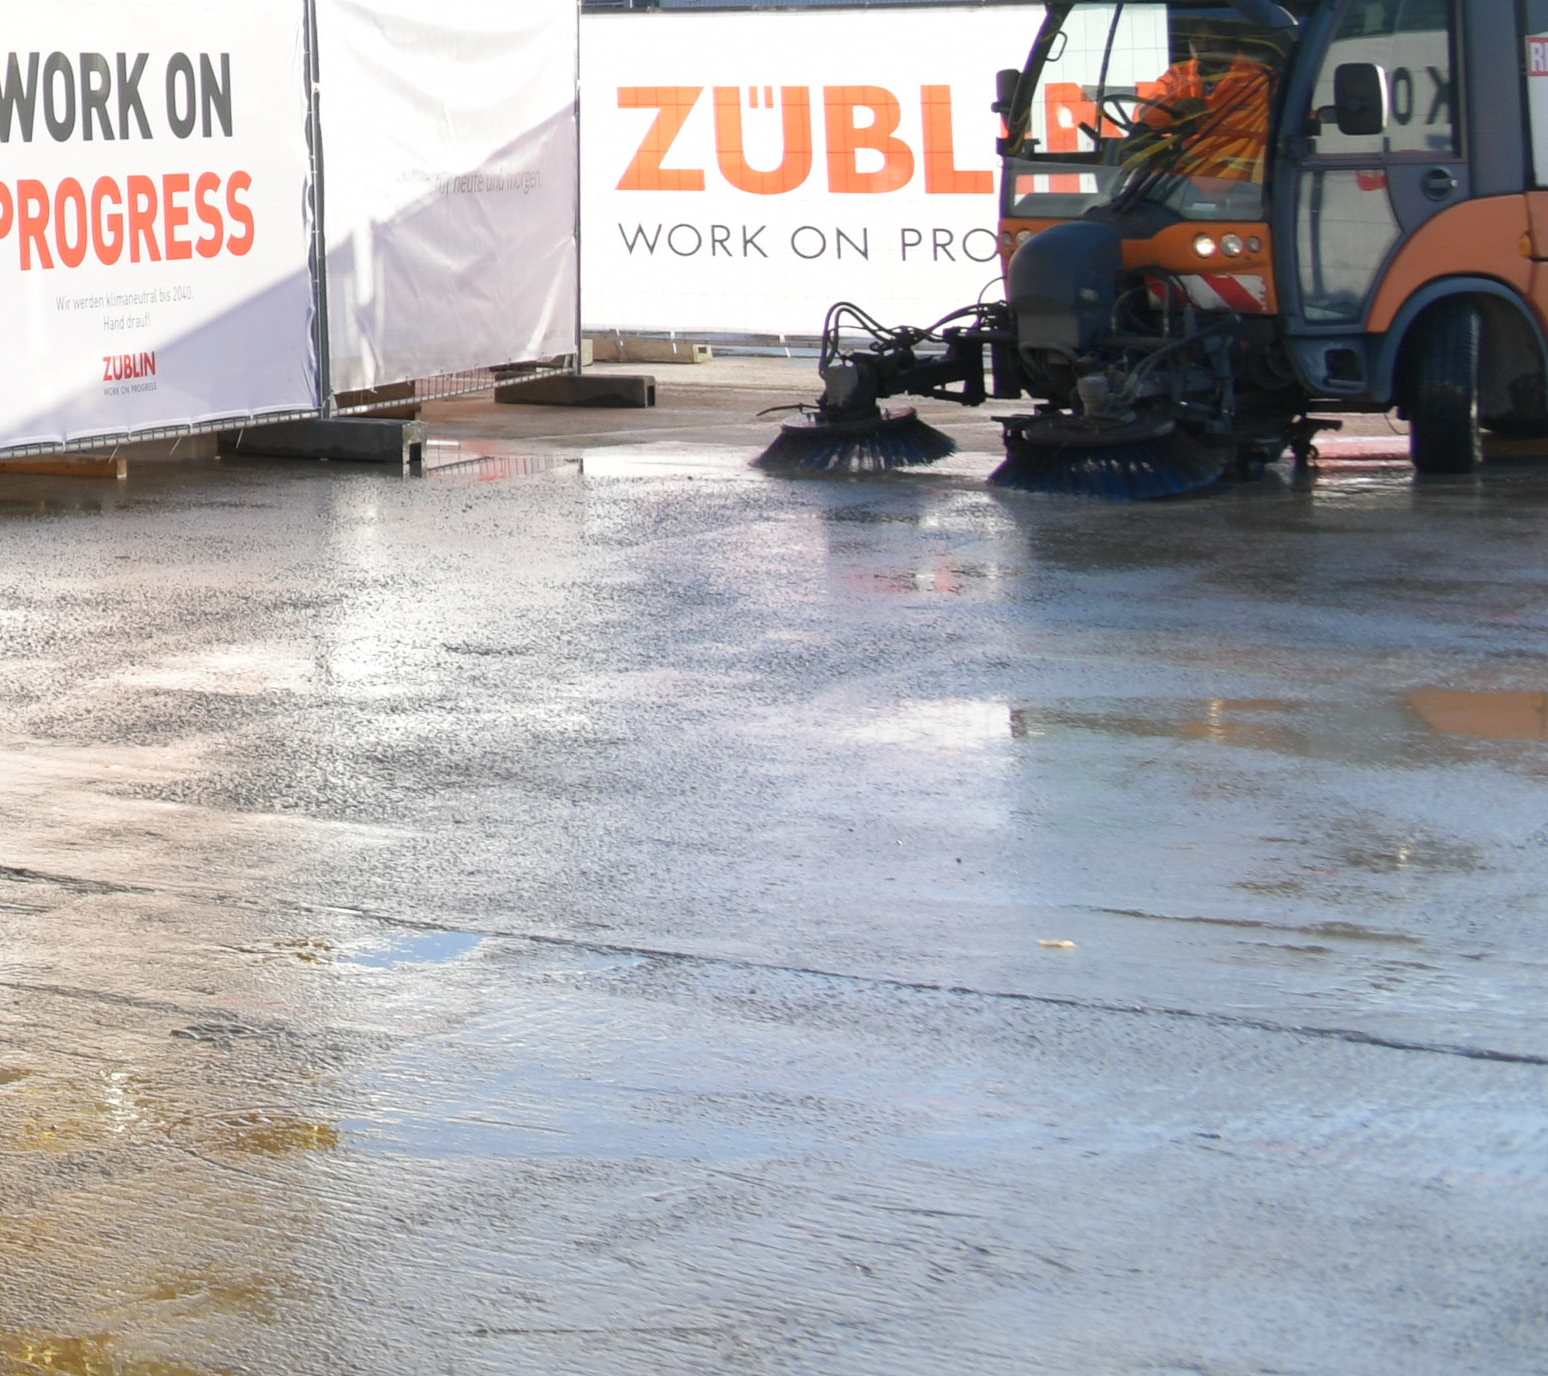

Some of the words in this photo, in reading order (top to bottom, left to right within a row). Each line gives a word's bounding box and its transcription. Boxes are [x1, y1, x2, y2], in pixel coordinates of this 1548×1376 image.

[166, 52, 233, 139] ON
[618, 222, 769, 258] WORK
[791, 225, 869, 260] ON
[55, 295, 71, 311] Wir
[72, 294, 104, 310] werden
[106, 289, 158, 307] klimaneutral
[159, 288, 172, 303] bis
[102, 315, 125, 331] Hand
[102, 351, 157, 382] ZÜBLIN
[103, 386, 120, 396] WORK
[120, 384, 130, 395] ON
